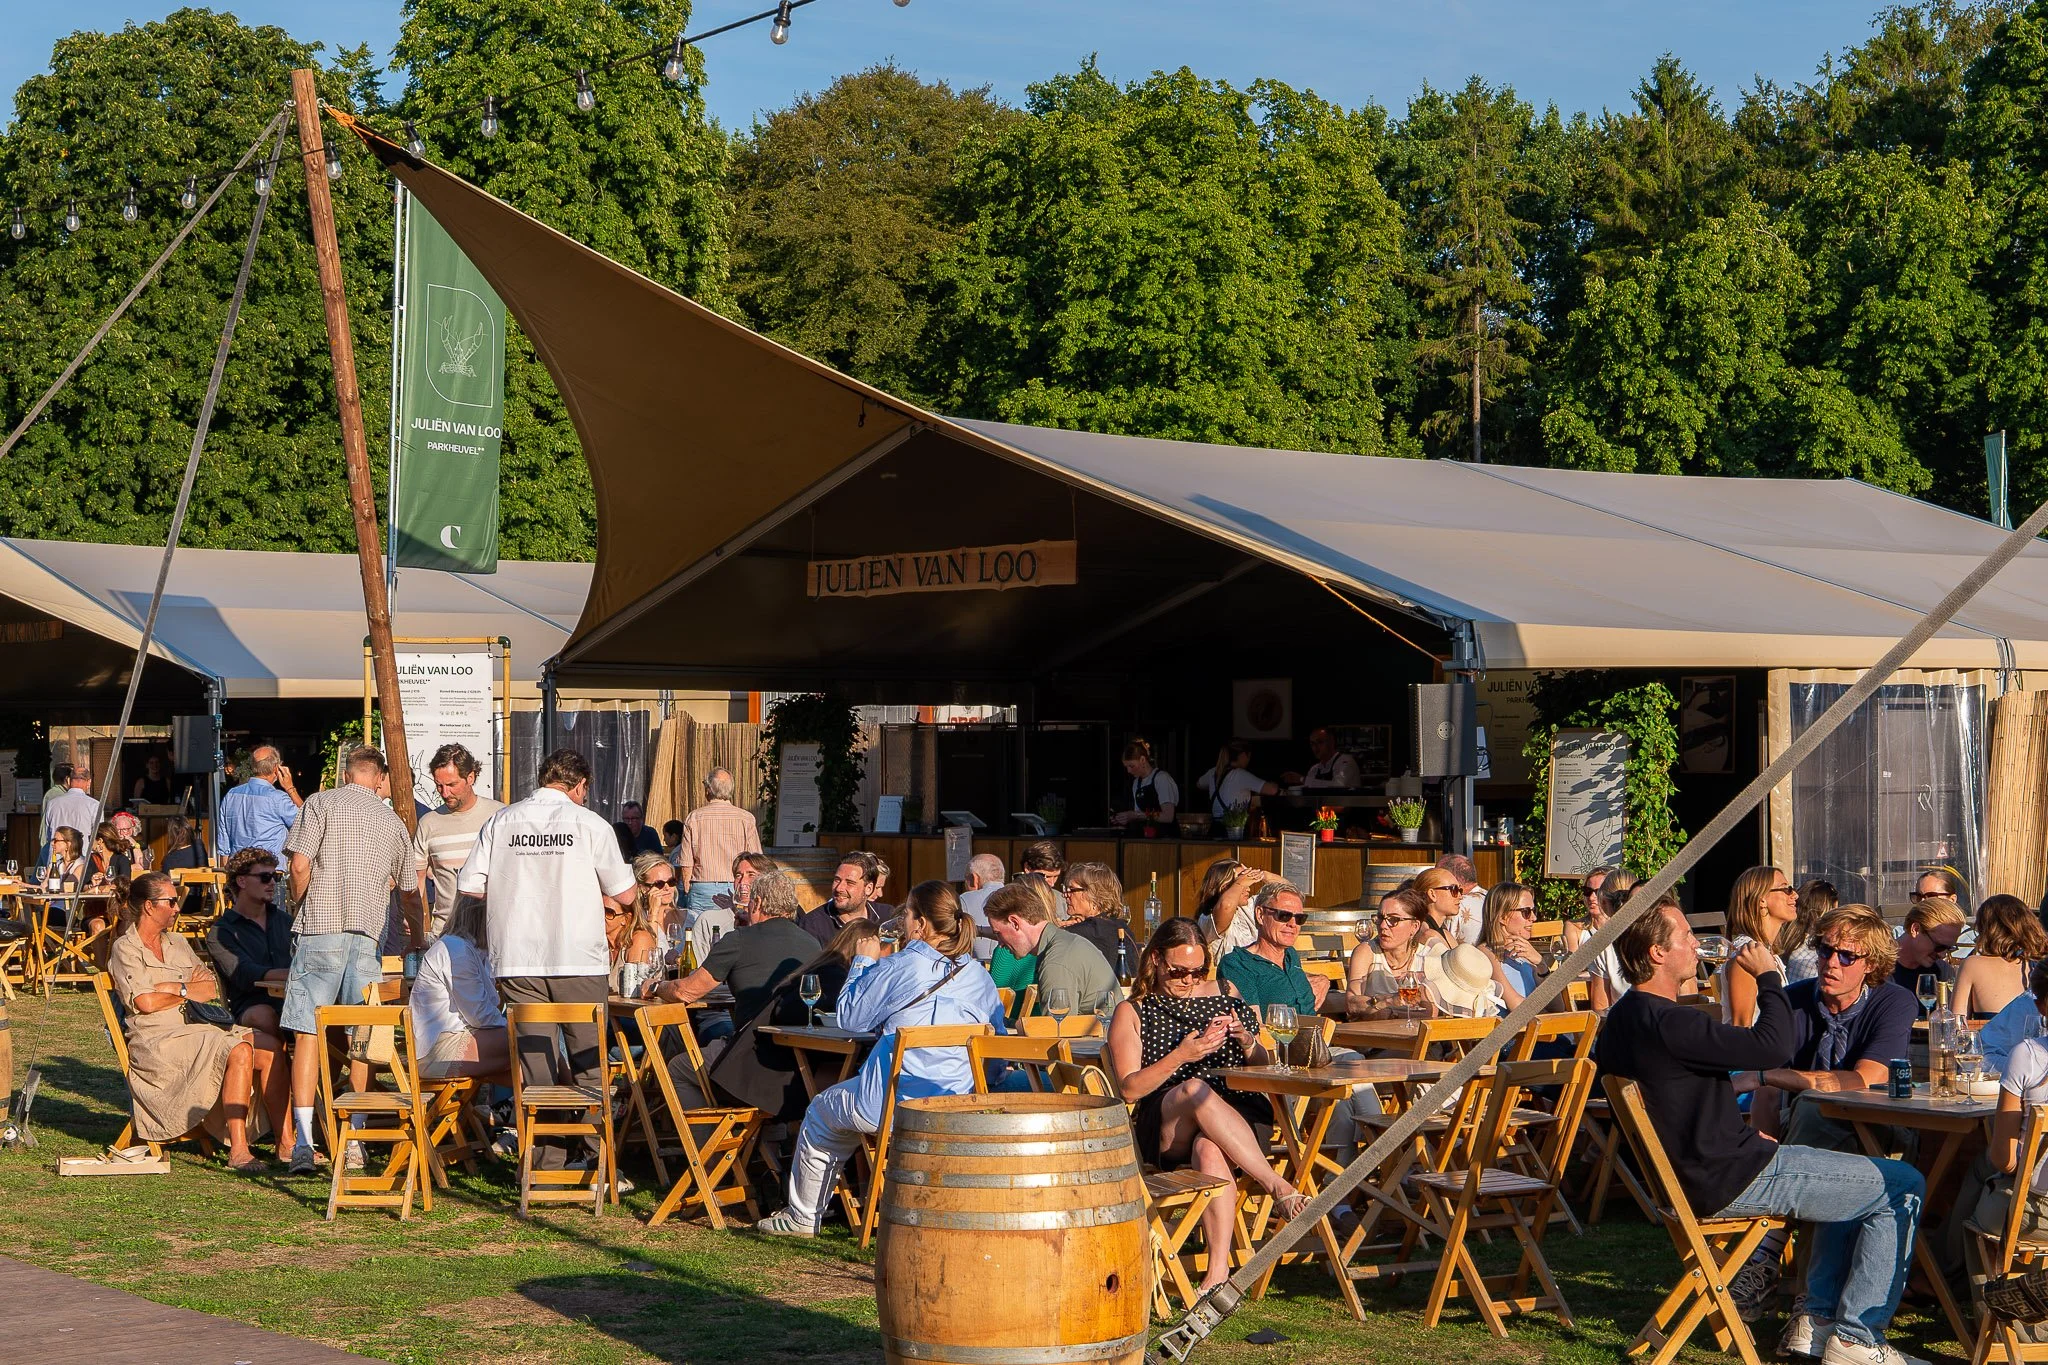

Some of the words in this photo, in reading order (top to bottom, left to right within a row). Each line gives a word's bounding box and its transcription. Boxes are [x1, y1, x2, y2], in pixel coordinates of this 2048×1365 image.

[411, 417, 451, 433] JULIËN
[452, 422, 476, 436] VAN
[478, 425, 501, 439] LOO
[815, 555, 905, 600] JULIËN
[913, 552, 967, 587] VAN
[978, 549, 1038, 584] LOO
[396, 664, 425, 675] ULIËN
[427, 666, 449, 675] VAN
[451, 666, 474, 675] LOO
[1487, 678, 1522, 692] JULIËN
[508, 833, 574, 847] JACQUEMUS
